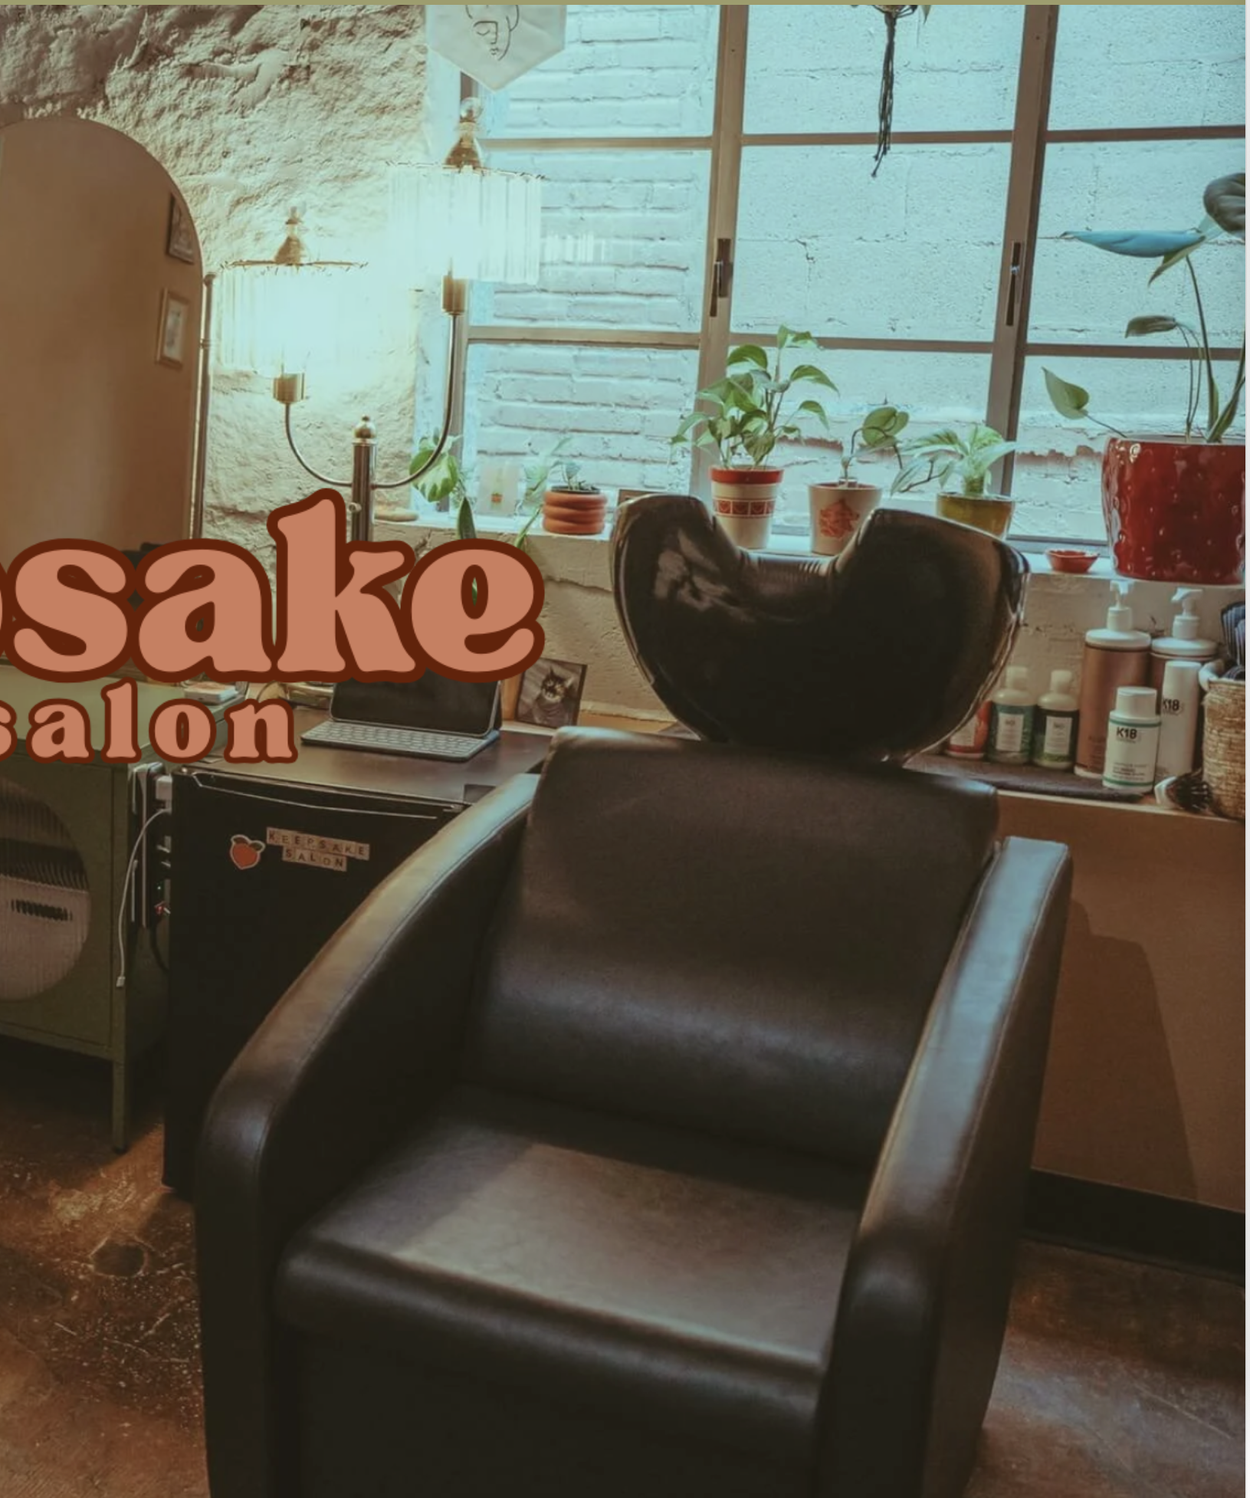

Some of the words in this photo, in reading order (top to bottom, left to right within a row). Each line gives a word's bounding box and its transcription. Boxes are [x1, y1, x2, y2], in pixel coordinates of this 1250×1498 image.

[1116, 727, 1137, 739] K18
[268, 829, 365, 856] KEEPSAKE
[285, 849, 344, 868] SALON
